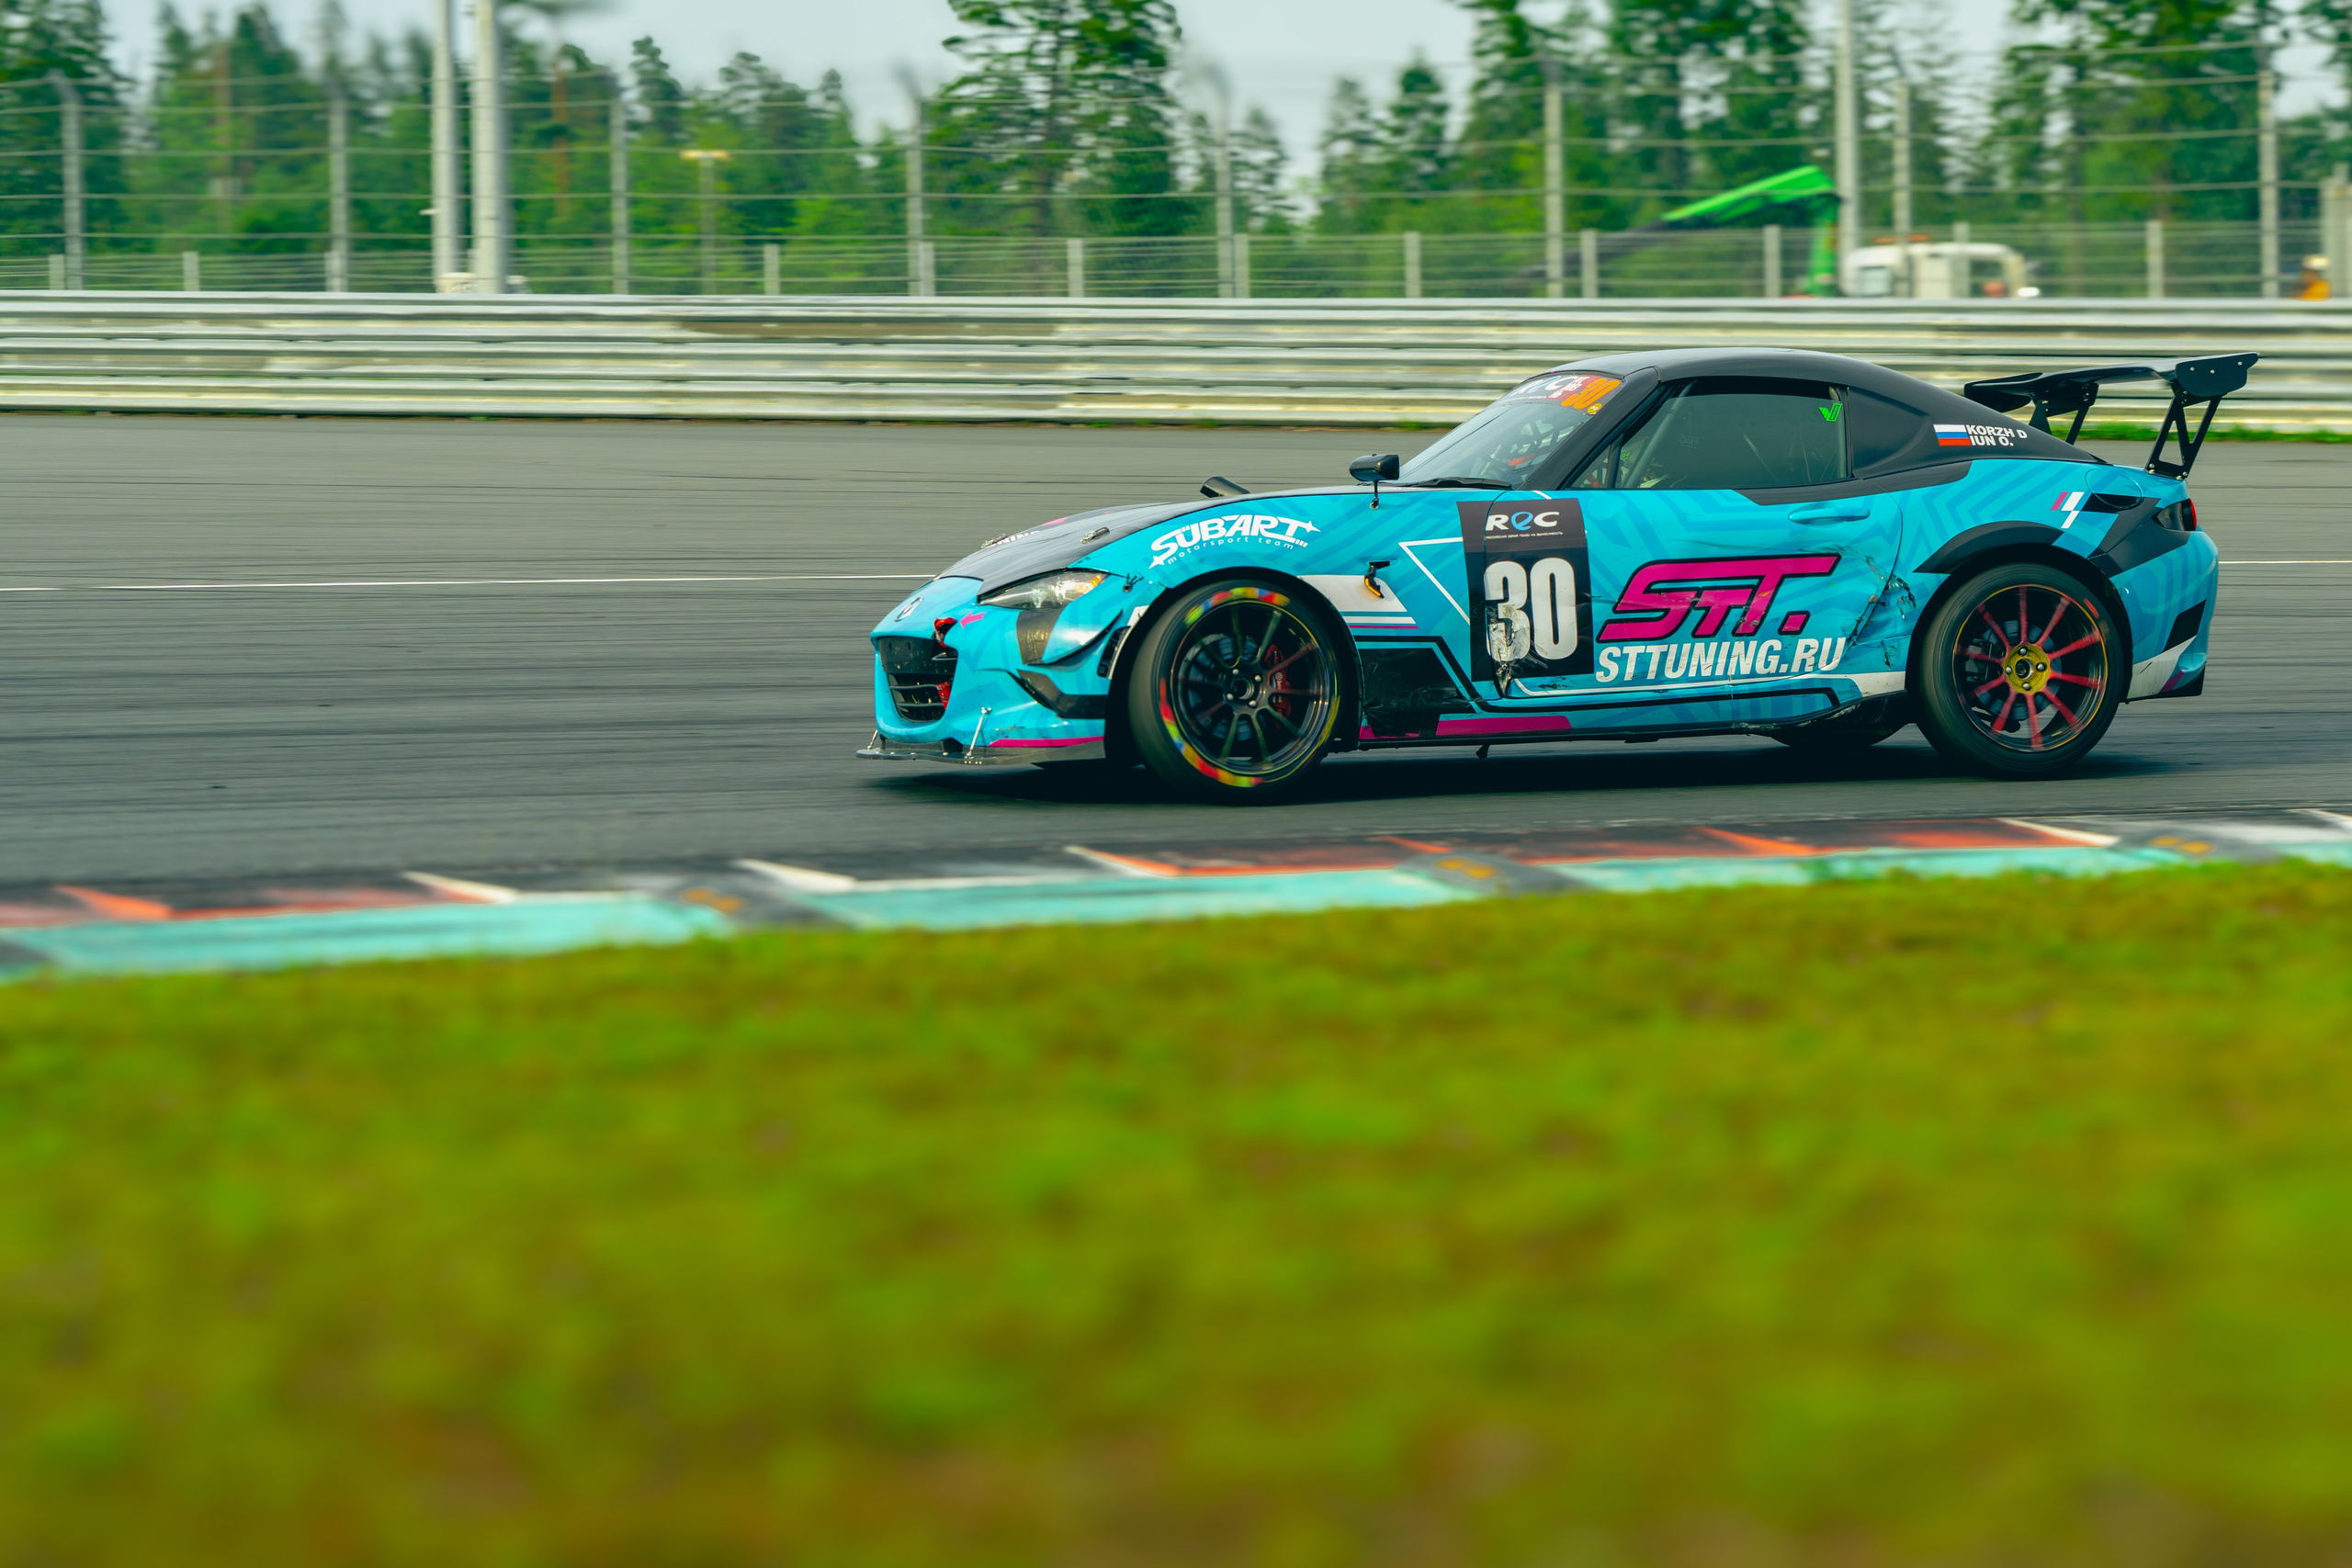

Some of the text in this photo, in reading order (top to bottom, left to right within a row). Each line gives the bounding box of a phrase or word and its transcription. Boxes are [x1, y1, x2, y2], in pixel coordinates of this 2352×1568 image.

[1561, 378, 1621, 410] 30
[1965, 424, 2028, 439] KORZH D
[1969, 435, 2015, 446] IUN O.
[1167, 536, 1294, 565] motorsport team
[1484, 557, 1578, 661] 30
[1595, 637, 1847, 683] STTUNING.RU
